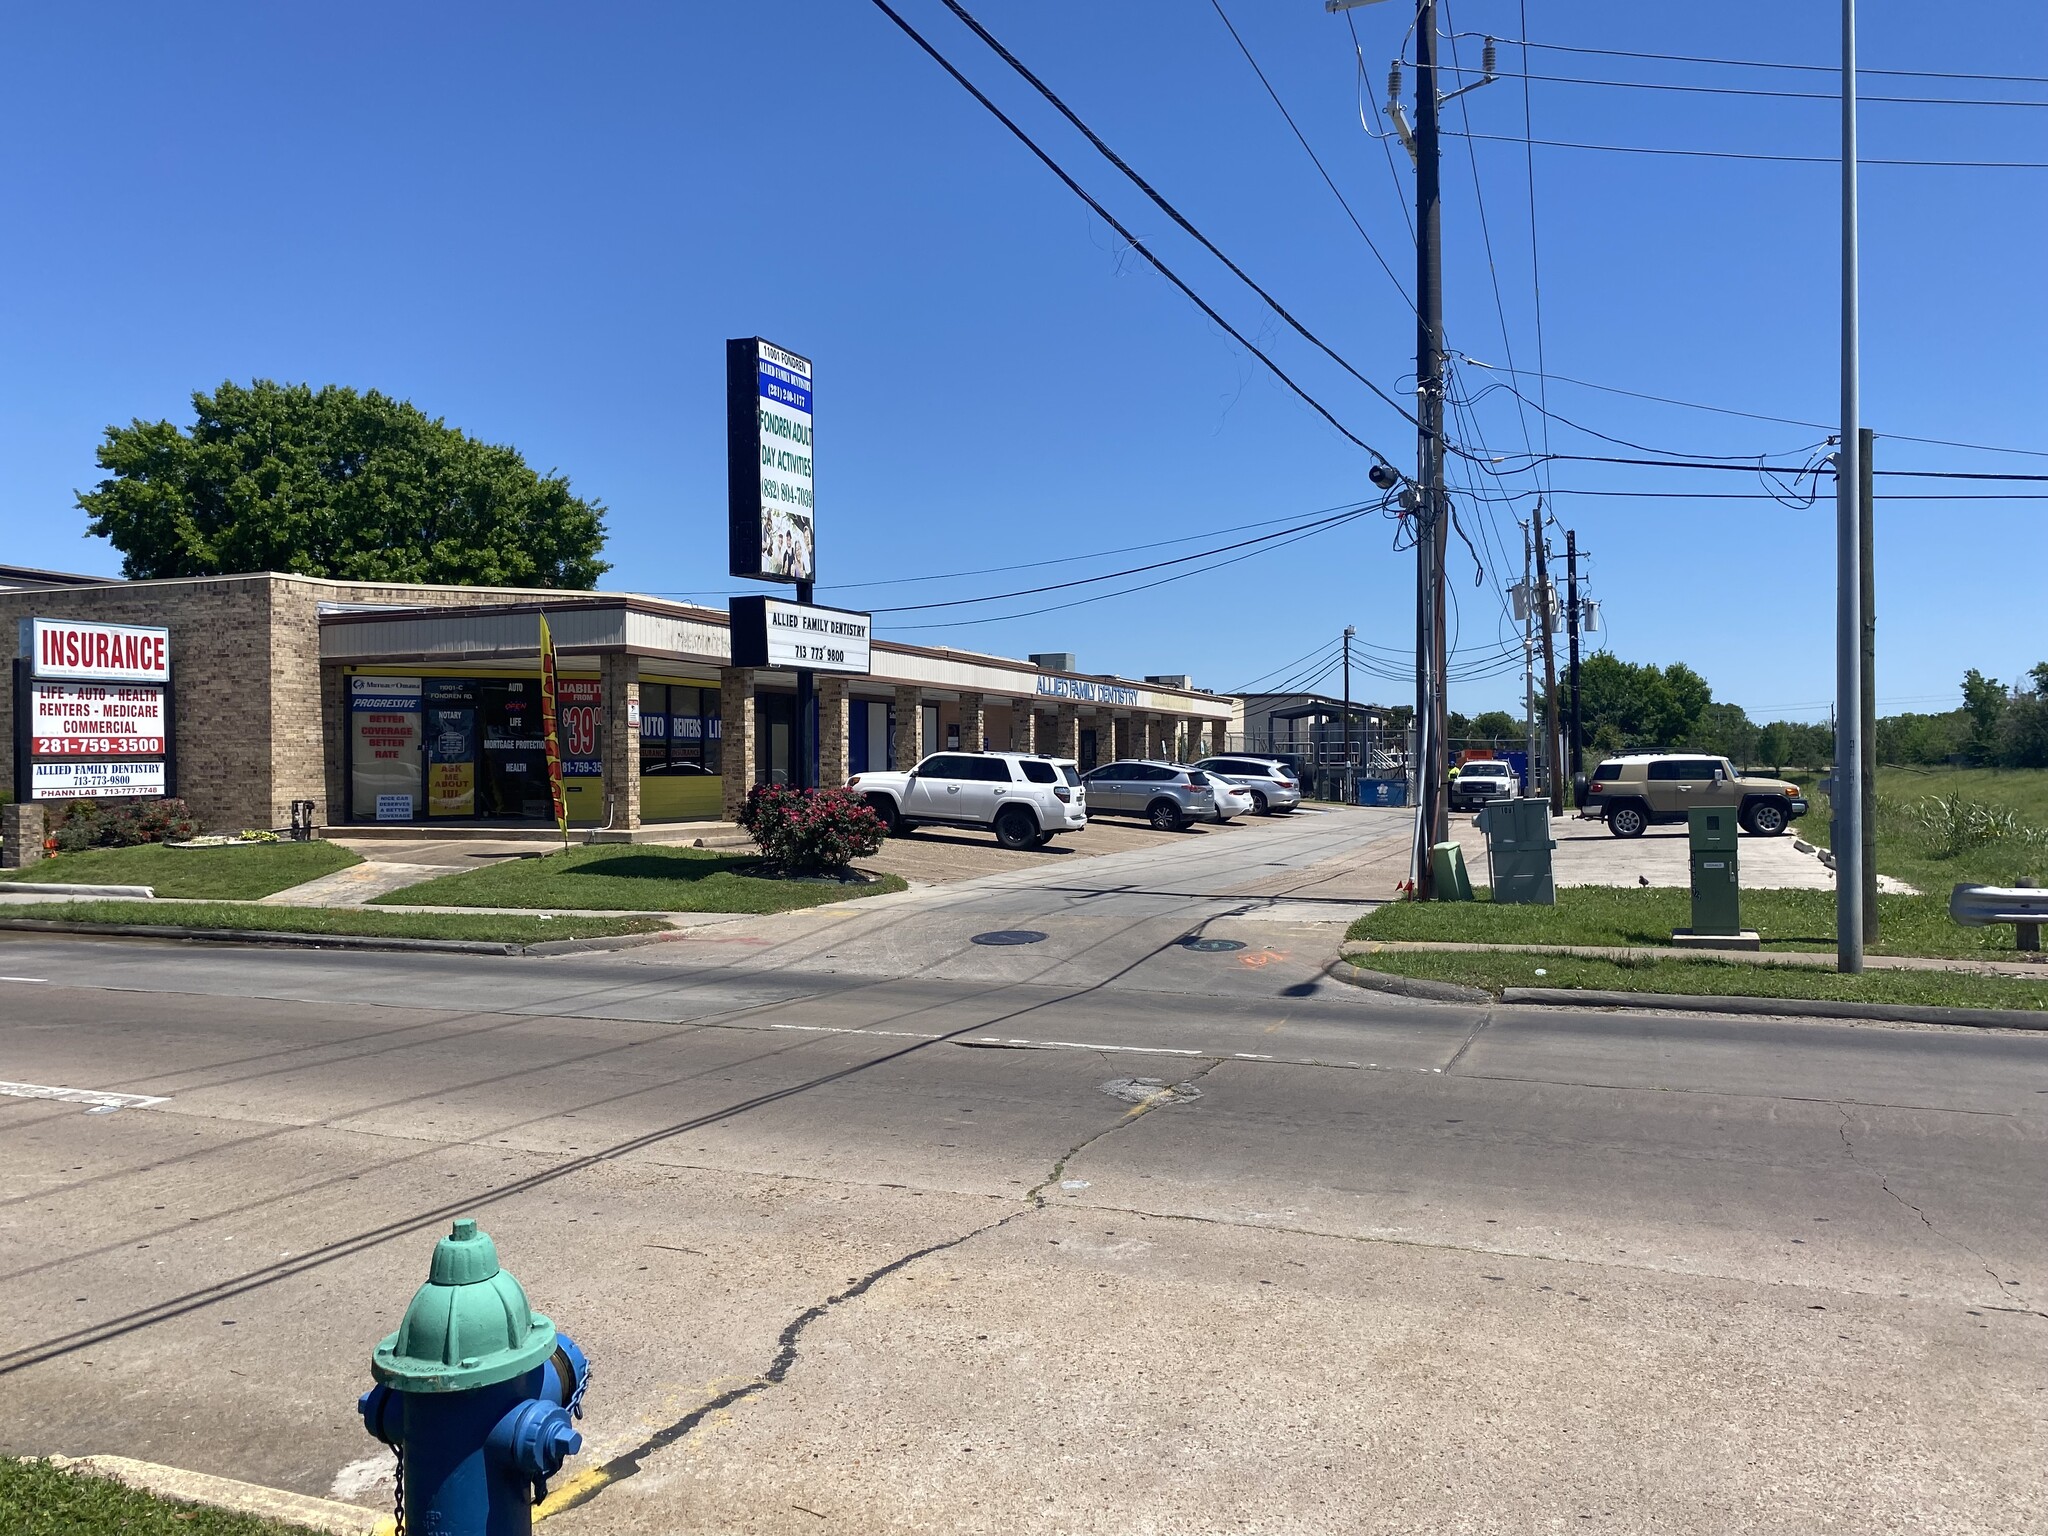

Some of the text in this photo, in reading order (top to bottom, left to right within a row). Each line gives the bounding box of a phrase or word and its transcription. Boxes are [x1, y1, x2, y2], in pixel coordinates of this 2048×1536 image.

[764, 345, 806, 373] 11001 FONDREN
[759, 361, 811, 392] ALLIED FAMILY DENTISTRY
[760, 410, 812, 447] FONDREN ADULT
[762, 445, 812, 478] DAY ACTIVITIES
[761, 477, 812, 508] (832) 804-7039
[772, 612, 866, 637] ALLIED FAMILY DENTISTRY
[42, 630, 165, 670] INSURANCE
[795, 645, 807, 659] 713
[827, 648, 844, 662] 9800
[508, 683, 524, 692] AUTO
[558, 682, 601, 693] LIABILIT
[1036, 676, 1138, 706] ALLIED FAMILY DENTISTRY
[40, 686, 64, 700] LIFE
[78, 688, 106, 701] AUTO
[118, 688, 157, 702] HEALTH
[353, 699, 416, 708] PROGRESSIVE
[505, 702, 527, 710] OPEN
[40, 703, 90, 716] RENTERS
[103, 705, 158, 718] MEDICARE
[439, 711, 461, 719] NOTARY
[369, 715, 404, 723] BETTER
[509, 718, 522, 726] LIFE
[64, 720, 137, 734] COMMERCIAL
[362, 727, 413, 735] COVERAGE
[673, 718, 701, 738] RENTERS
[709, 720, 721, 738] LIF
[39, 739, 158, 753] 281-759-3500
[484, 740, 546, 749] MORTGAGE PROTECTIO
[375, 750, 399, 759] RATE
[36, 764, 160, 776] ALLIED FAMILY DENTISTRY
[441, 765, 462, 773] ASK
[506, 763, 527, 772] HEALTH
[562, 762, 602, 772] 81-759-35
[73, 776, 130, 785] 713-773-9800
[435, 780, 469, 788] ABOUT
